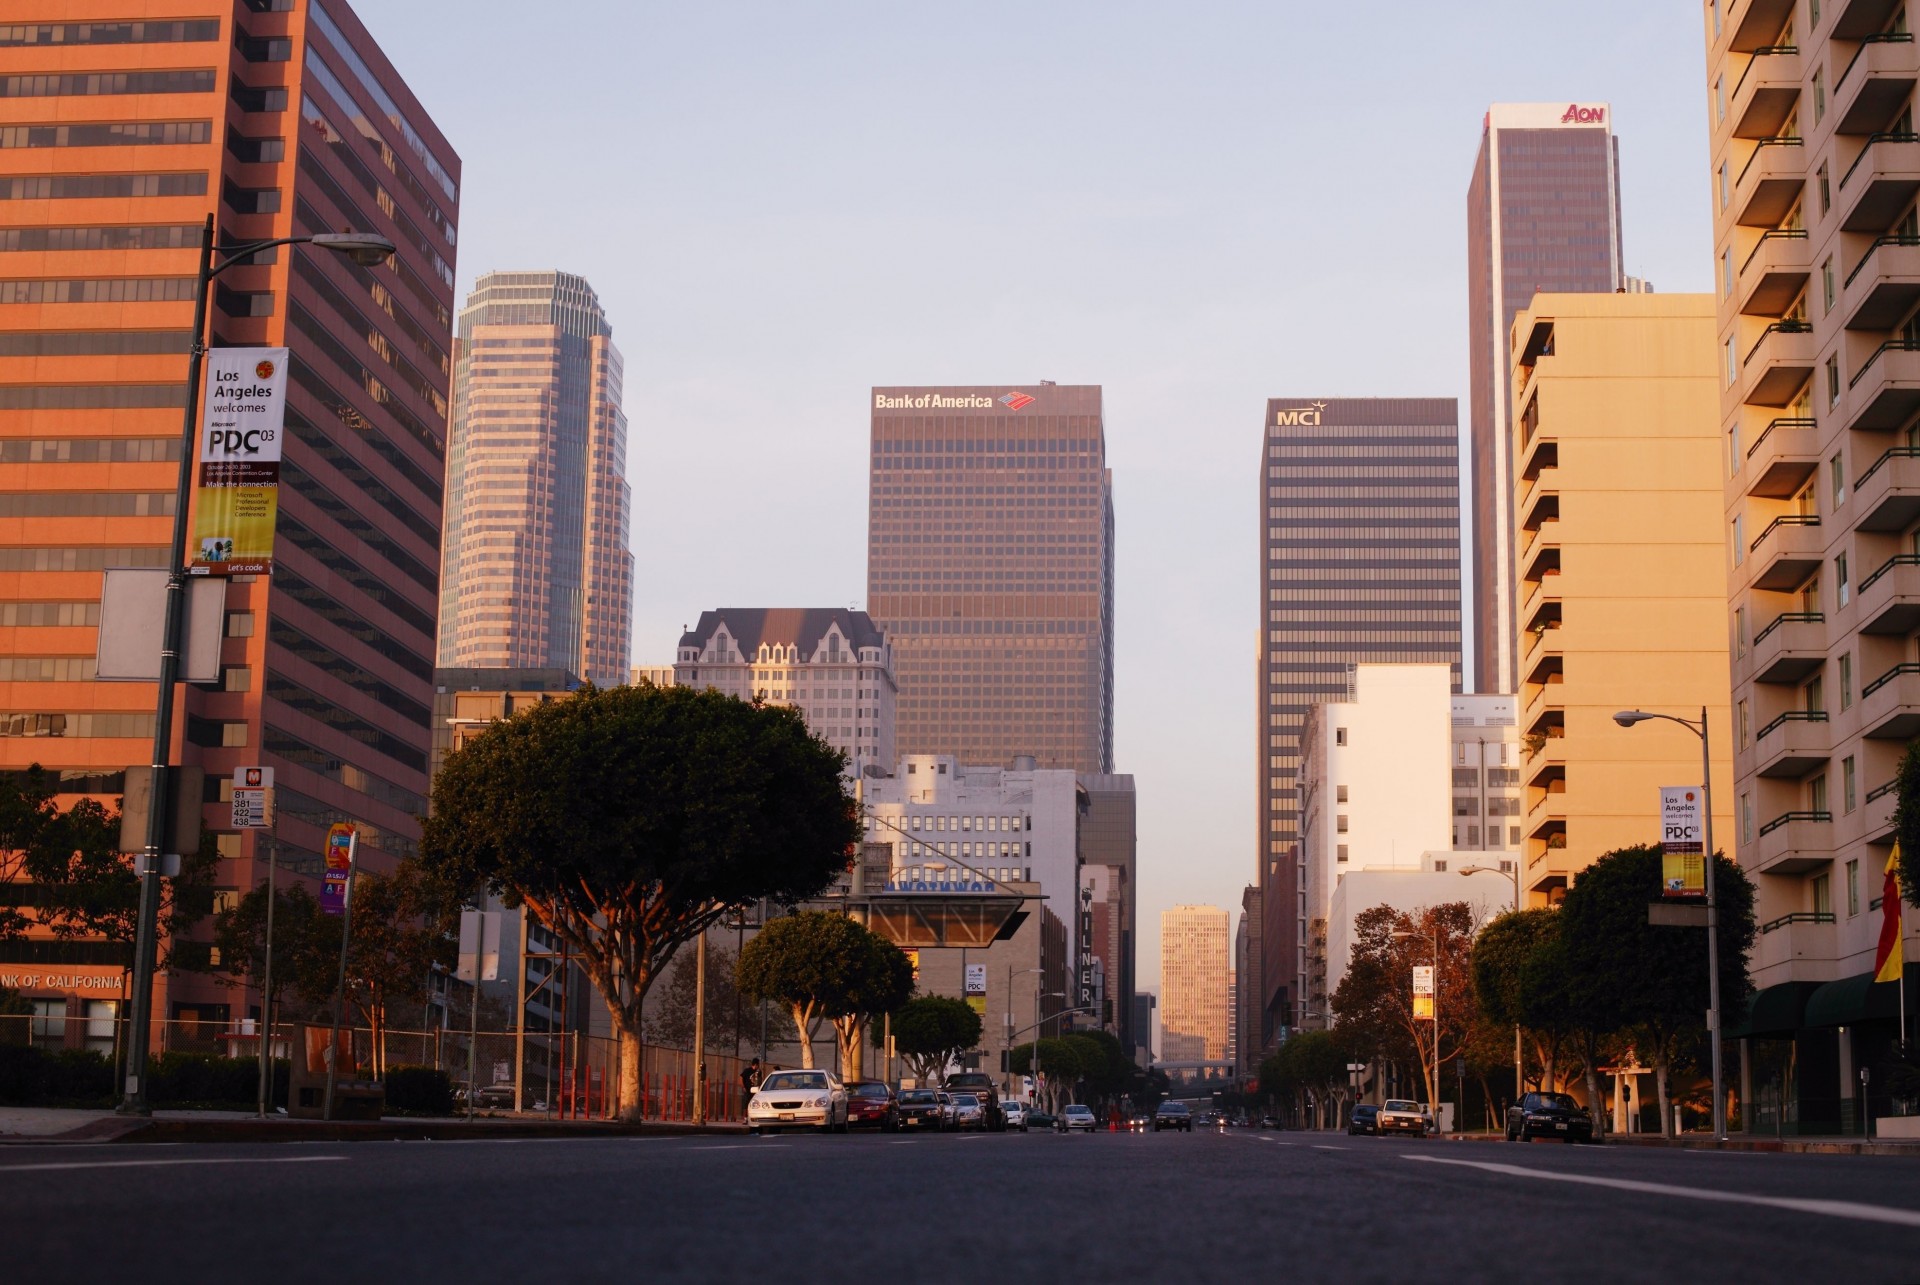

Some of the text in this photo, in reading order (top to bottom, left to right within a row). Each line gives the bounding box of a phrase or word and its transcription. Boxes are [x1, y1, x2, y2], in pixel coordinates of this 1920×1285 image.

[216, 369, 240, 382] Los
[214, 384, 272, 400] Angeles
[875, 394, 993, 409] Bank of America
[213, 402, 266, 413] welcomes
[1277, 411, 1321, 426] MCI
[226, 480, 237, 488] the
[239, 480, 278, 488] connection
[227, 564, 264, 572] Let's code
[234, 790, 245, 799] 81
[234, 800, 250, 808] 381
[1665, 804, 1695, 813] Angeles
[233, 809, 250, 817] 422
[233, 818, 249, 826] 438
[1081, 899, 1092, 1002] MILNER
[23, 974, 40, 988] OF
[46, 974, 122, 989] CALIFORNIA
